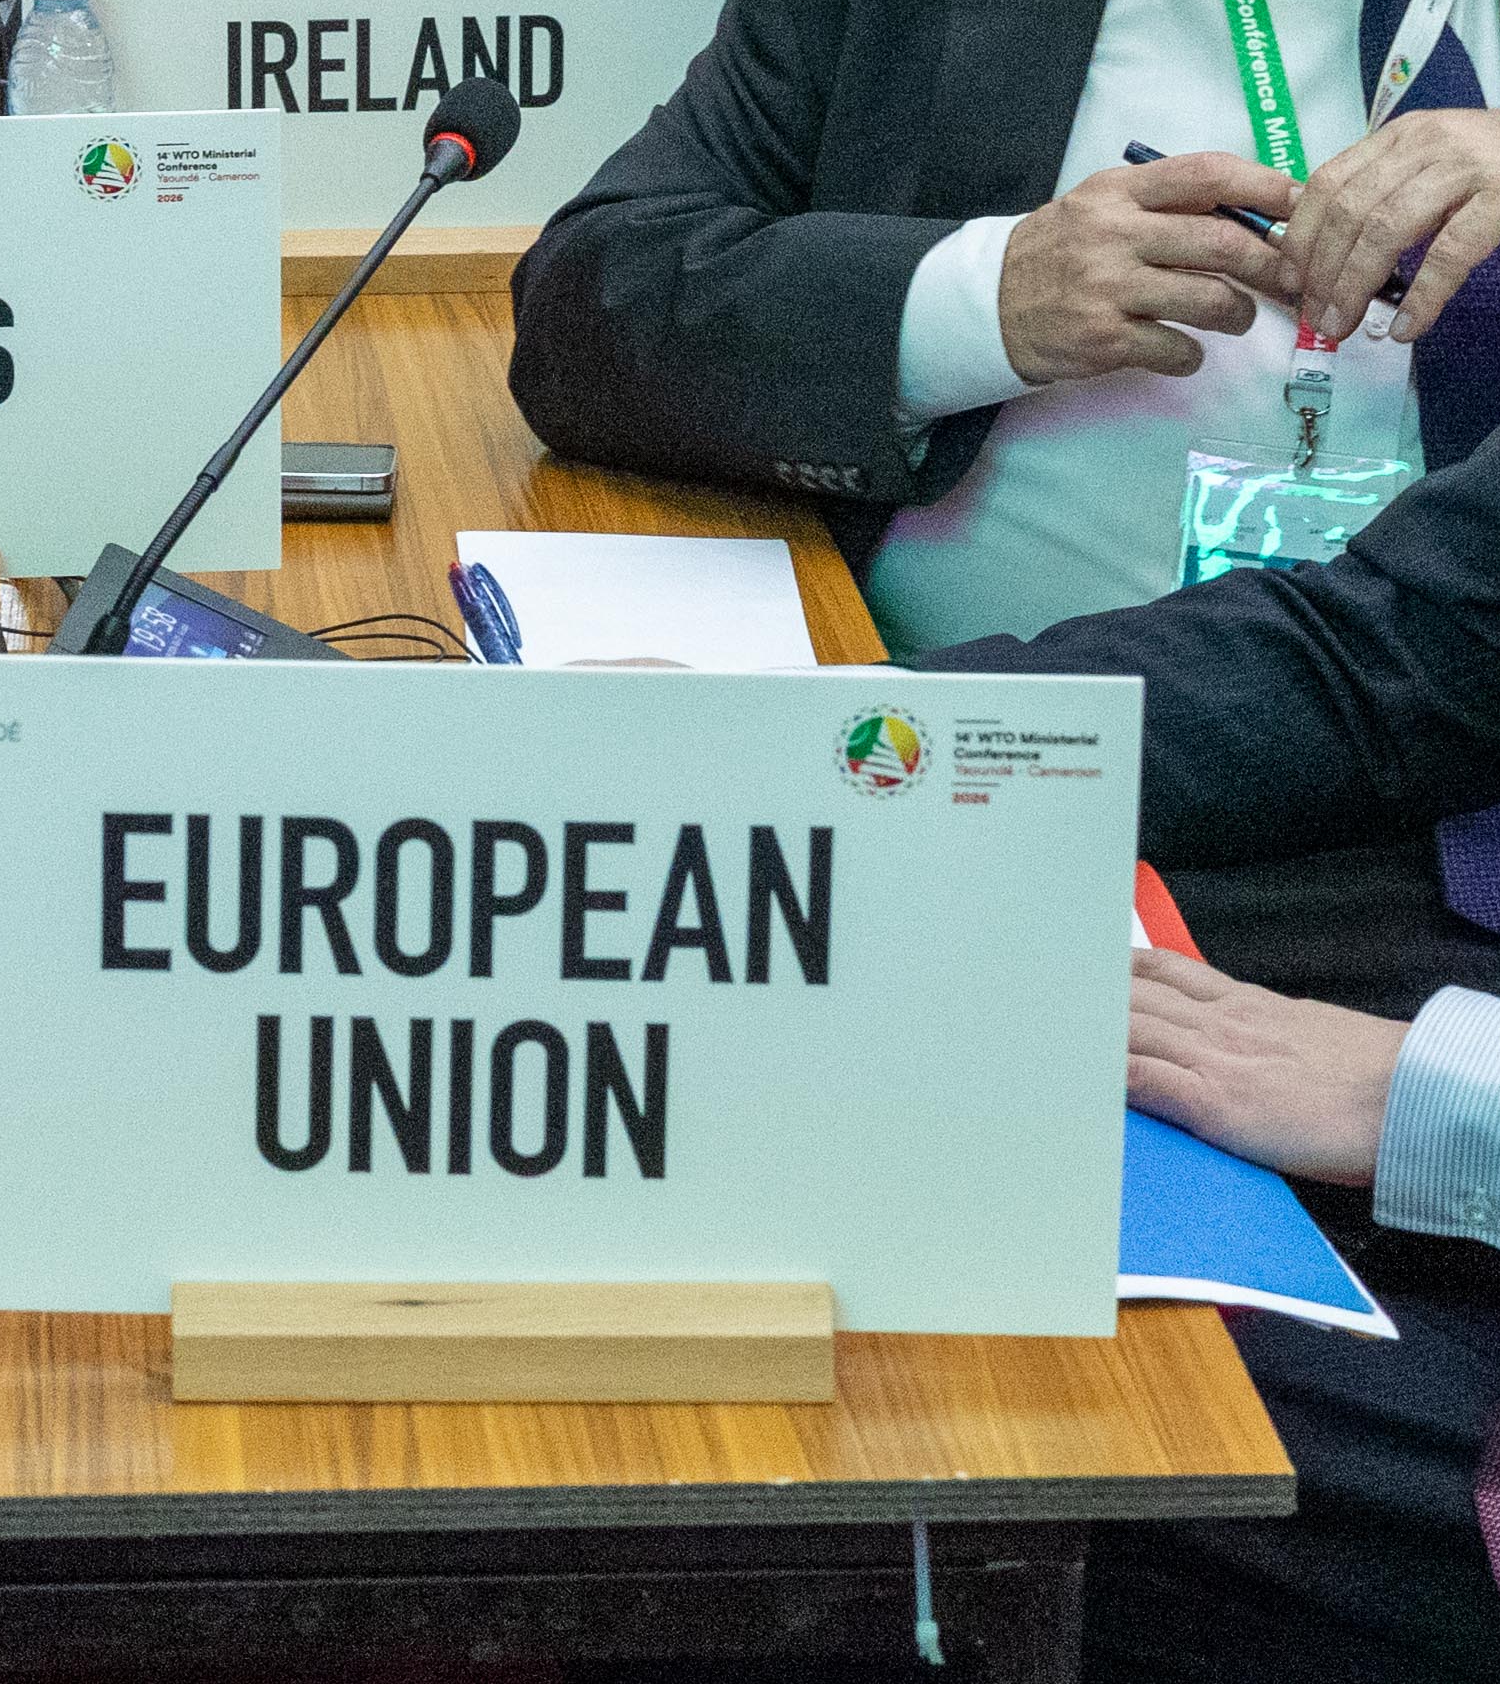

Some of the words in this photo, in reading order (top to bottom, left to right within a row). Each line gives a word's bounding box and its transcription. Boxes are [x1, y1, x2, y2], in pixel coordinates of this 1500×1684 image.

[227, 14, 564, 113] IRELAND
[173, 151, 200, 160] WTO
[202, 149, 256, 159] Ministerial
[157, 162, 218, 172] Conference
[157, 173, 200, 183] Yaoundé
[208, 172, 260, 182] Cameroon
[157, 194, 184, 203] 2026
[978, 732, 1016, 745] WTO
[1019, 732, 1099, 746] Ministerial
[953, 748, 1041, 761] Conference
[100, 811, 836, 987] EUROPEAN
[254, 1014, 671, 1179] UNION
